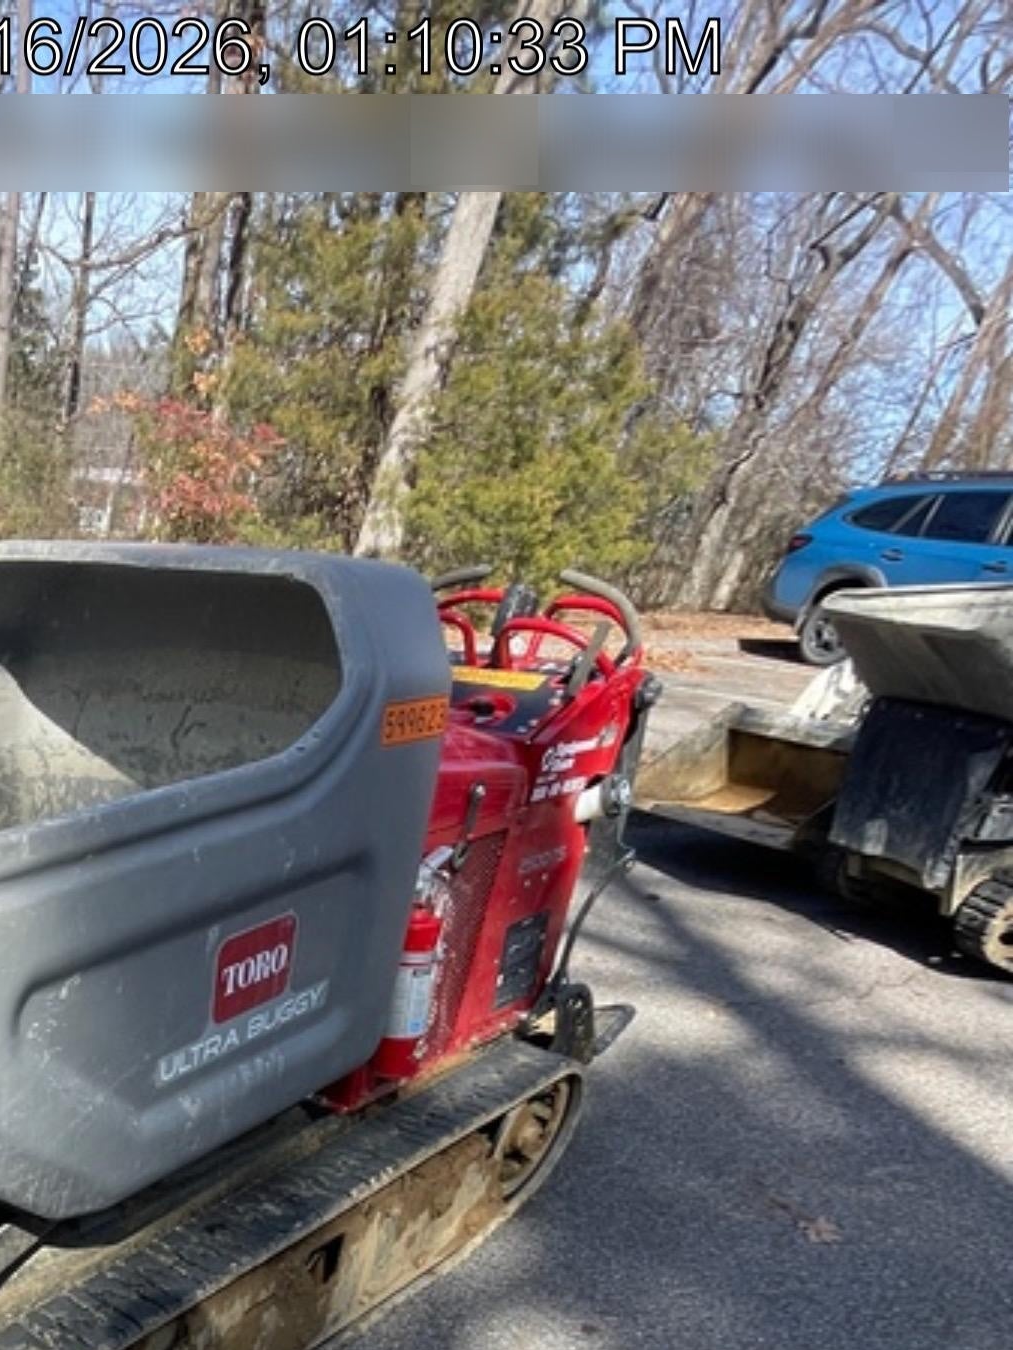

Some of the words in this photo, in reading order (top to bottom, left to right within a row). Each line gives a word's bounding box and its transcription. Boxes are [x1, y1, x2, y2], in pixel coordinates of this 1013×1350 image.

[221, 944, 288, 997] TORO
[159, 1028, 239, 1081] ULTRA
[248, 984, 326, 1039] BUGGY
